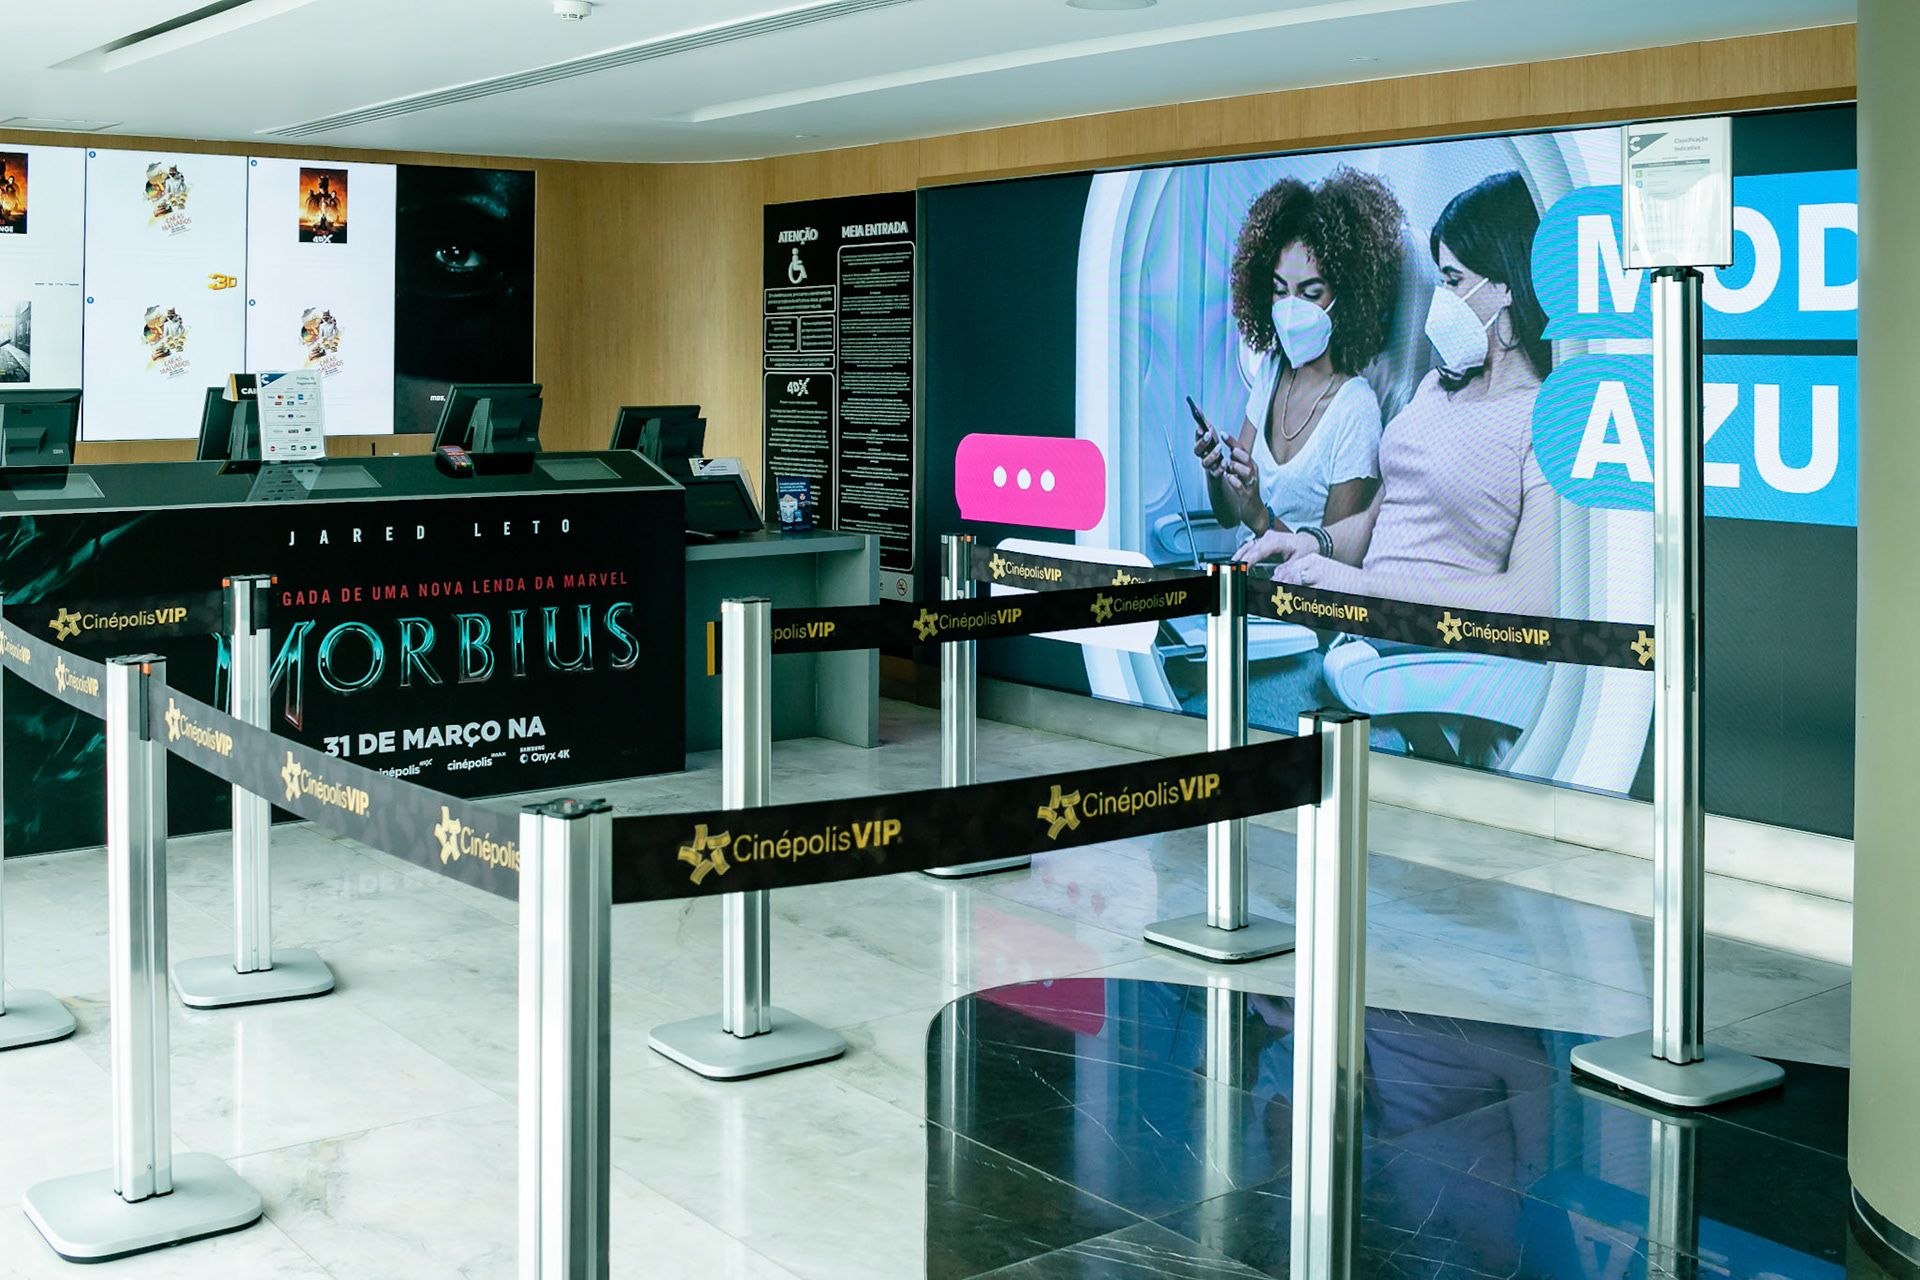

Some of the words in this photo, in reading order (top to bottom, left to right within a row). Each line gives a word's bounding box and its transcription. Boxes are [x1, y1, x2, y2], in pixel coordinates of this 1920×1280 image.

[1674, 136, 1708, 144] Classificação
[778, 227, 819, 245] ATENÇÃO
[841, 225, 864, 238] MEIA
[865, 221, 909, 236] ENTRADA
[208, 273, 238, 290] 3D
[787, 378, 811, 397] 4DX
[289, 525, 425, 546] JARED
[474, 519, 570, 537] LETO
[282, 590, 331, 606] GADA
[341, 587, 363, 603] DE
[372, 584, 409, 601] UMA
[419, 581, 463, 598] NOVA
[473, 577, 525, 594] LENDA
[535, 575, 554, 590] DA
[563, 572, 627, 588] MARVEL
[771, 622, 835, 643] polisVIP
[211, 602, 640, 732] MORBIUS
[323, 735, 350, 758] 31
[358, 731, 396, 756] DE
[403, 720, 502, 750] MARÇO
[508, 716, 546, 739] NA
[447, 758, 493, 772] cinépolis
[530, 751, 556, 764] Onyx
[557, 749, 570, 760] 4K
[377, 766, 421, 779] inépolis
[460, 826, 520, 872] Cinépolis
